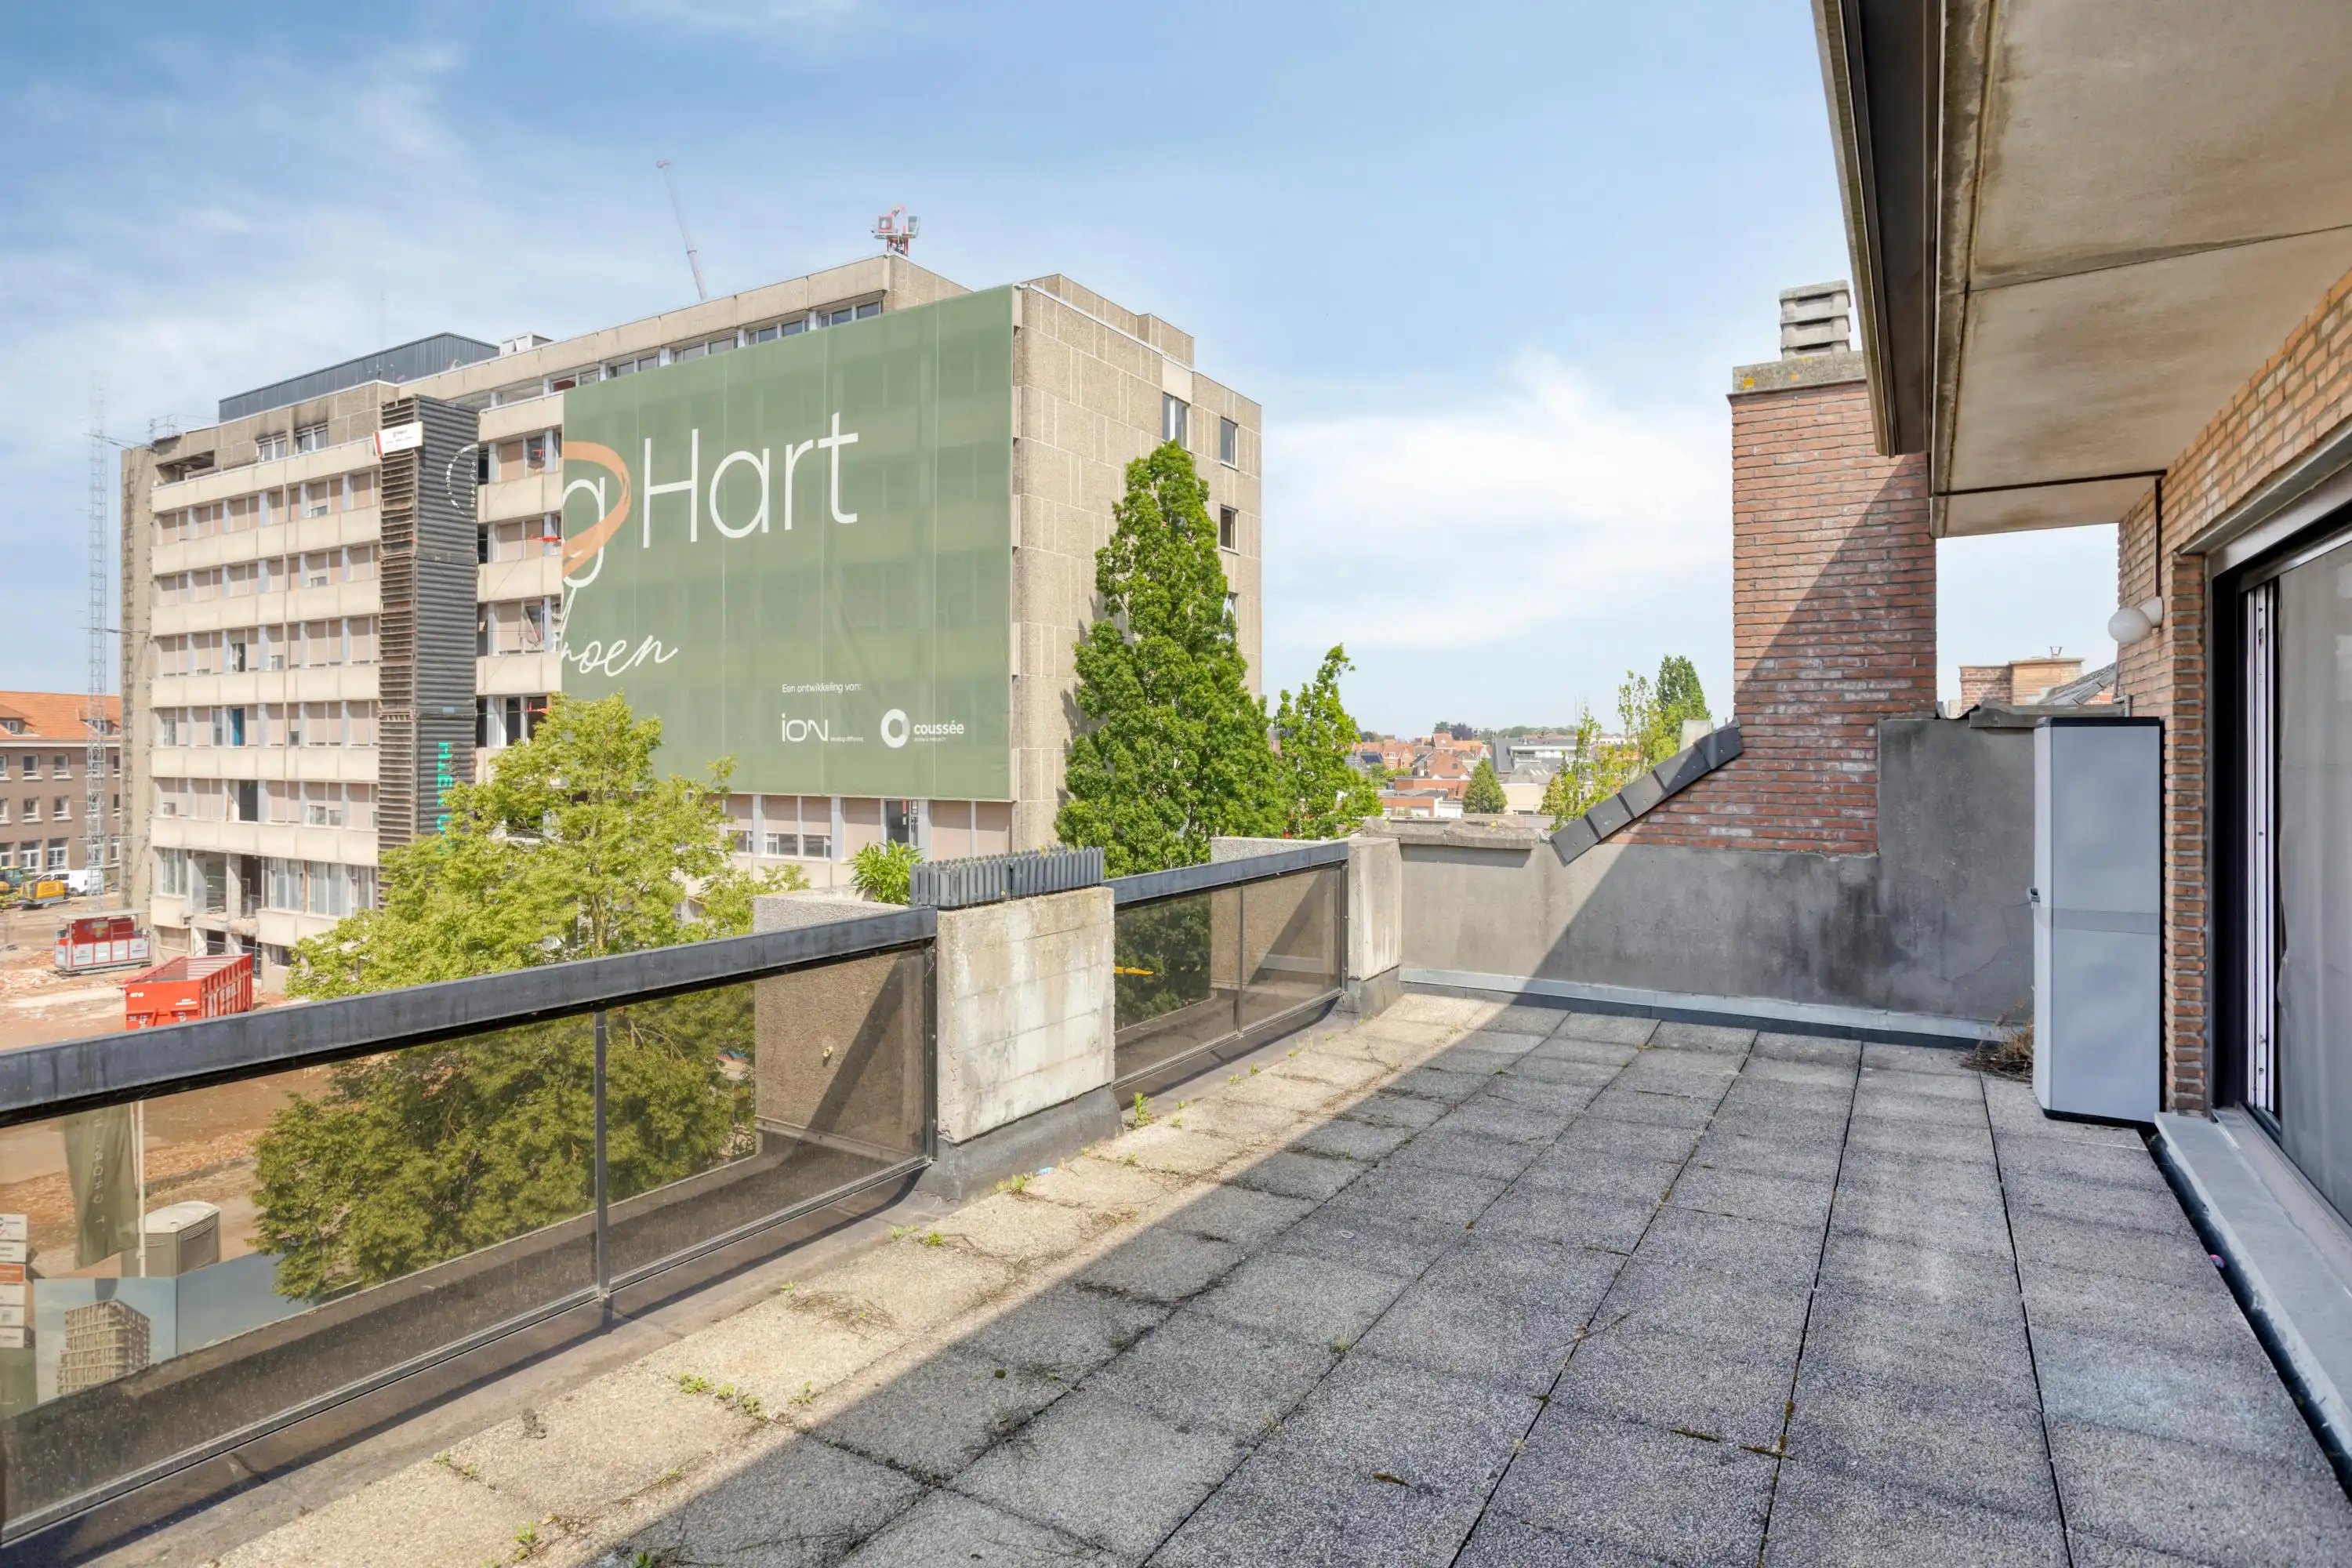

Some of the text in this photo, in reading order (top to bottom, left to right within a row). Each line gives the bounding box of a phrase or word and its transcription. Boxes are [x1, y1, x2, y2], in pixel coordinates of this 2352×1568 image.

[643, 412, 858, 549] Hart
[782, 682, 862, 694] Een ontwikkeling van:
[913, 720, 965, 735] coussée
